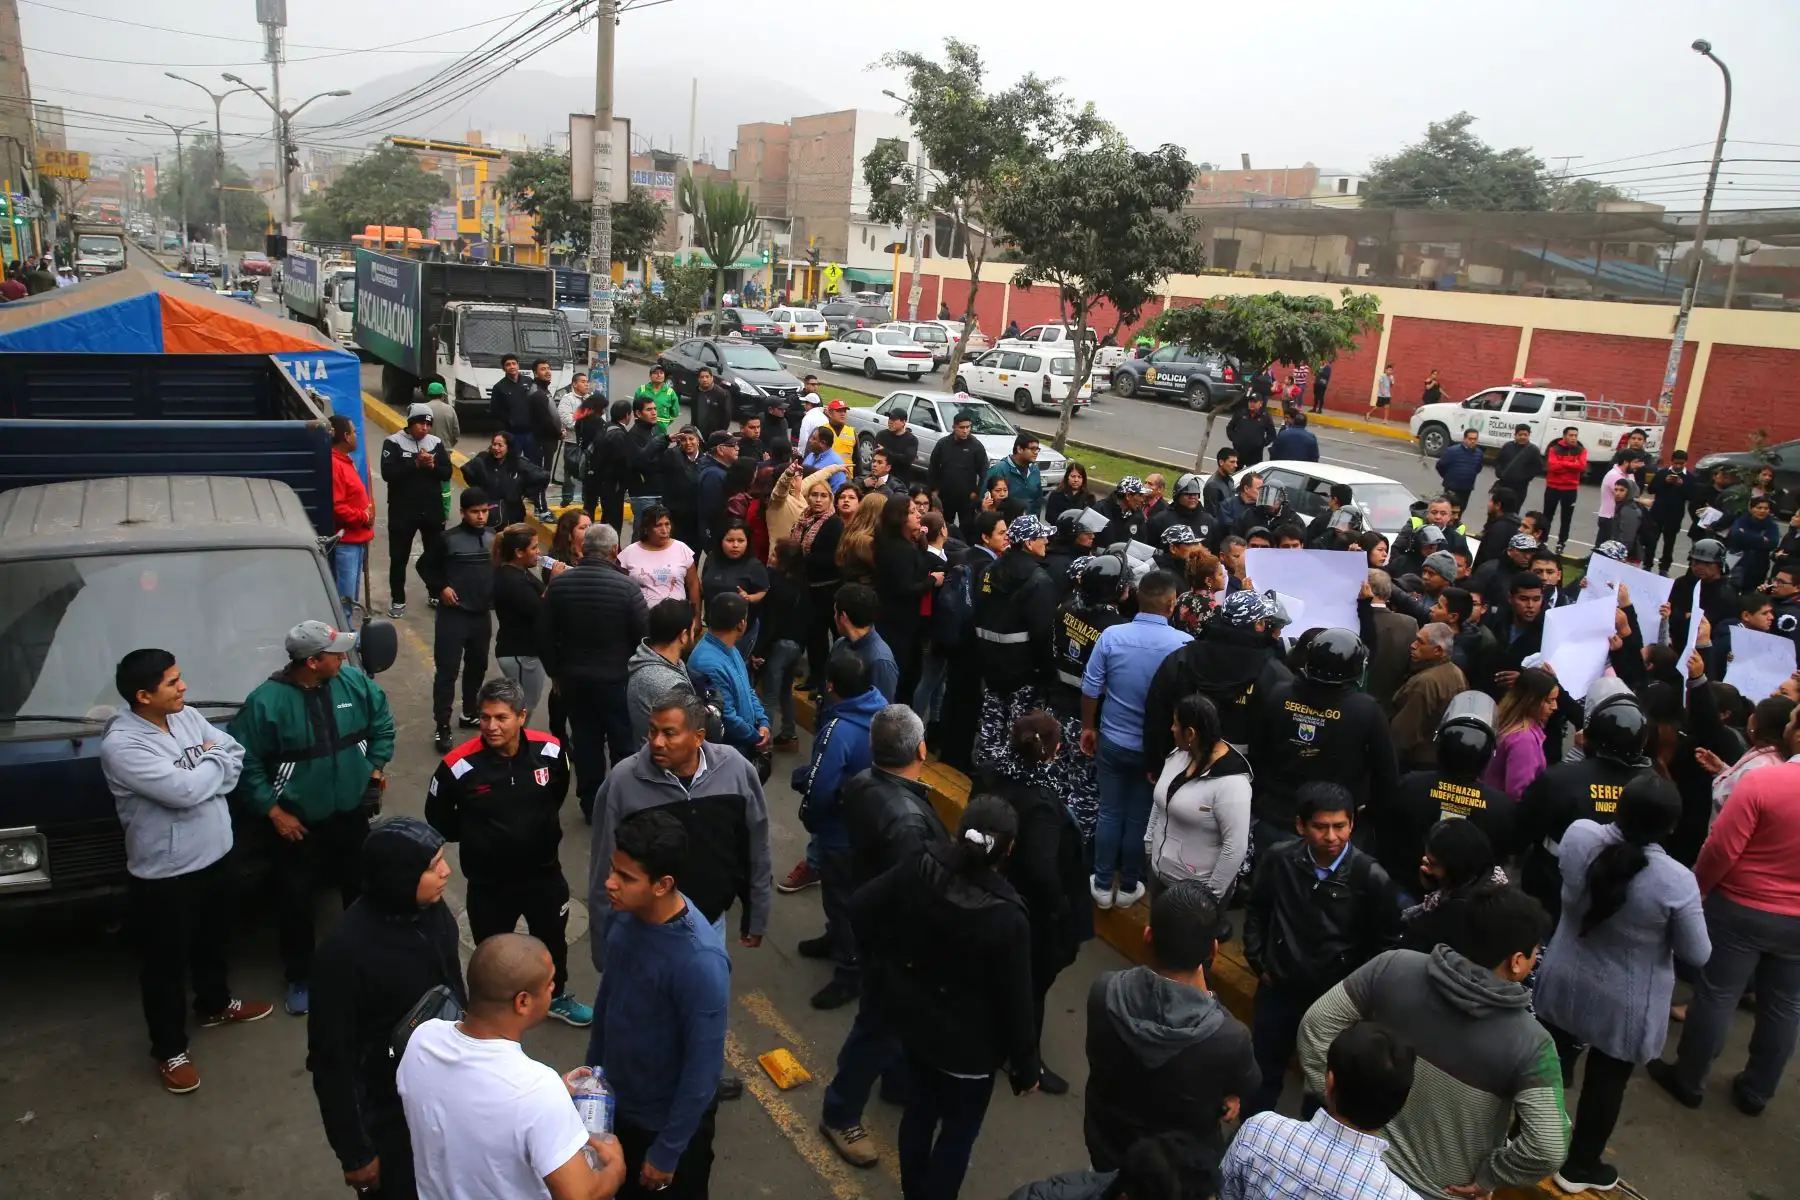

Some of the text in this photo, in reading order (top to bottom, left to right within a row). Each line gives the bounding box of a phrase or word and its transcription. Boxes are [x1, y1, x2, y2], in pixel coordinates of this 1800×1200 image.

[357, 288, 414, 349] FISCALIZACIÓN
[1157, 372, 1187, 383] POLICIA
[1430, 788, 1487, 809] INDEPENDENCIA
[1438, 781, 1481, 798] SERENAZGO
